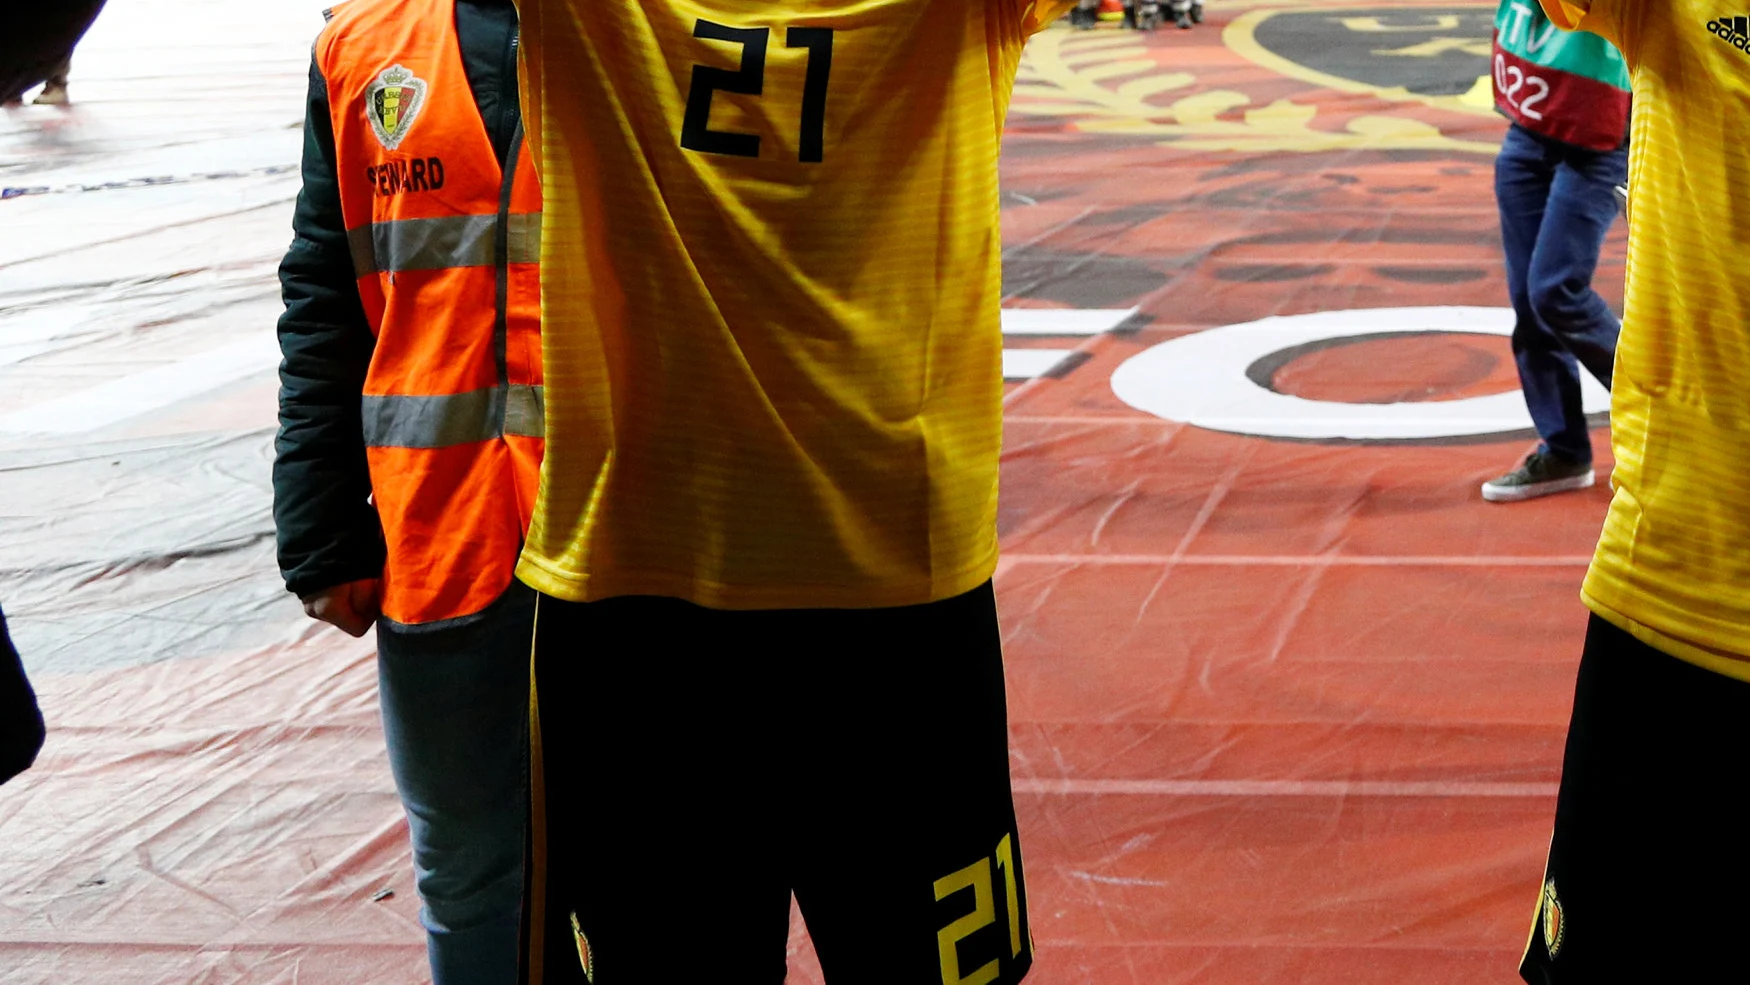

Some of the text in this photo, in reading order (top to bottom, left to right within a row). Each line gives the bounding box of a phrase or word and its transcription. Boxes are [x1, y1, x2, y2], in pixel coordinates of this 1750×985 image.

[1509, 1, 1557, 54] TV
[680, 18, 834, 163] 21
[367, 156, 445, 197] SEWARD
[933, 832, 1022, 985] 21
